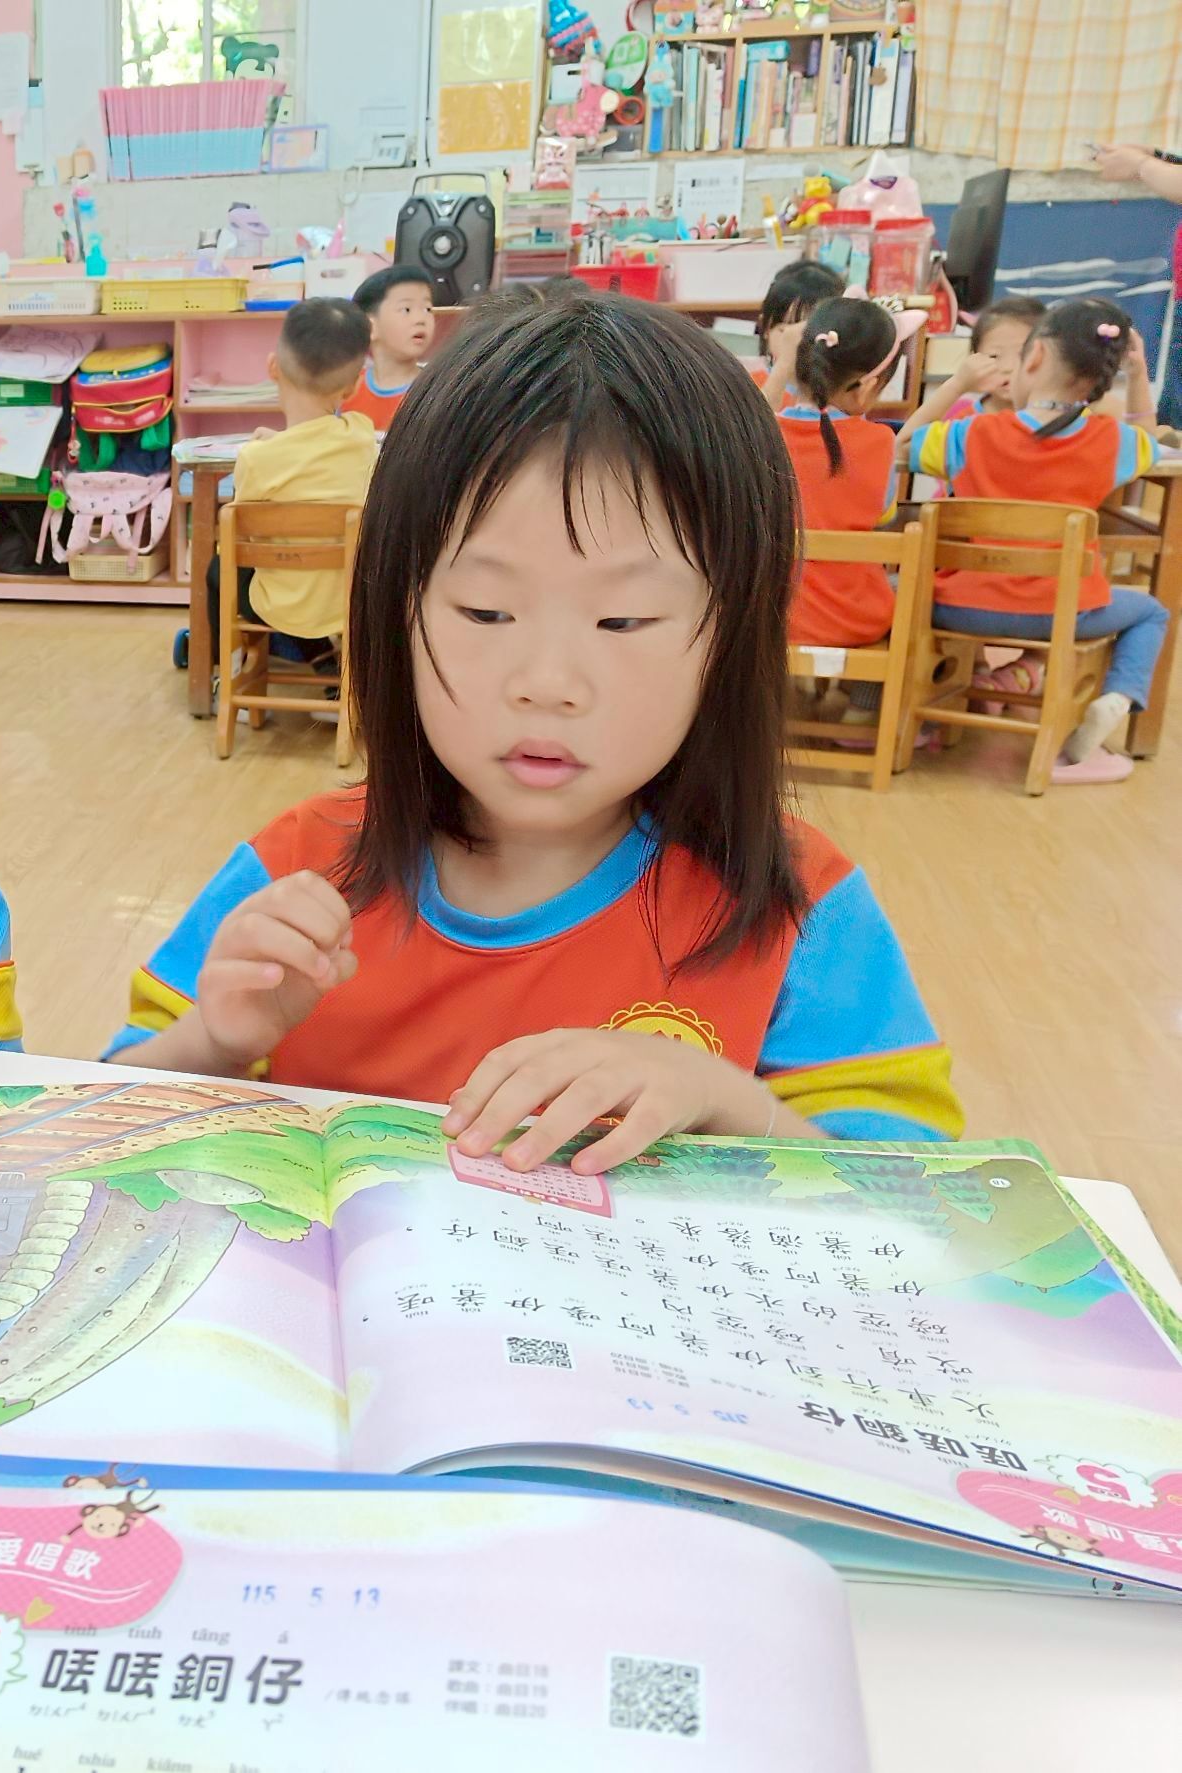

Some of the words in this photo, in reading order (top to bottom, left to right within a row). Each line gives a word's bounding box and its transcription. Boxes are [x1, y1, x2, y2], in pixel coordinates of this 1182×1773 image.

[1075, 1464, 1131, 1501] 5
[241, 1583, 276, 1606] 115
[308, 1586, 324, 1608] 5
[351, 1586, 382, 1609] 13
